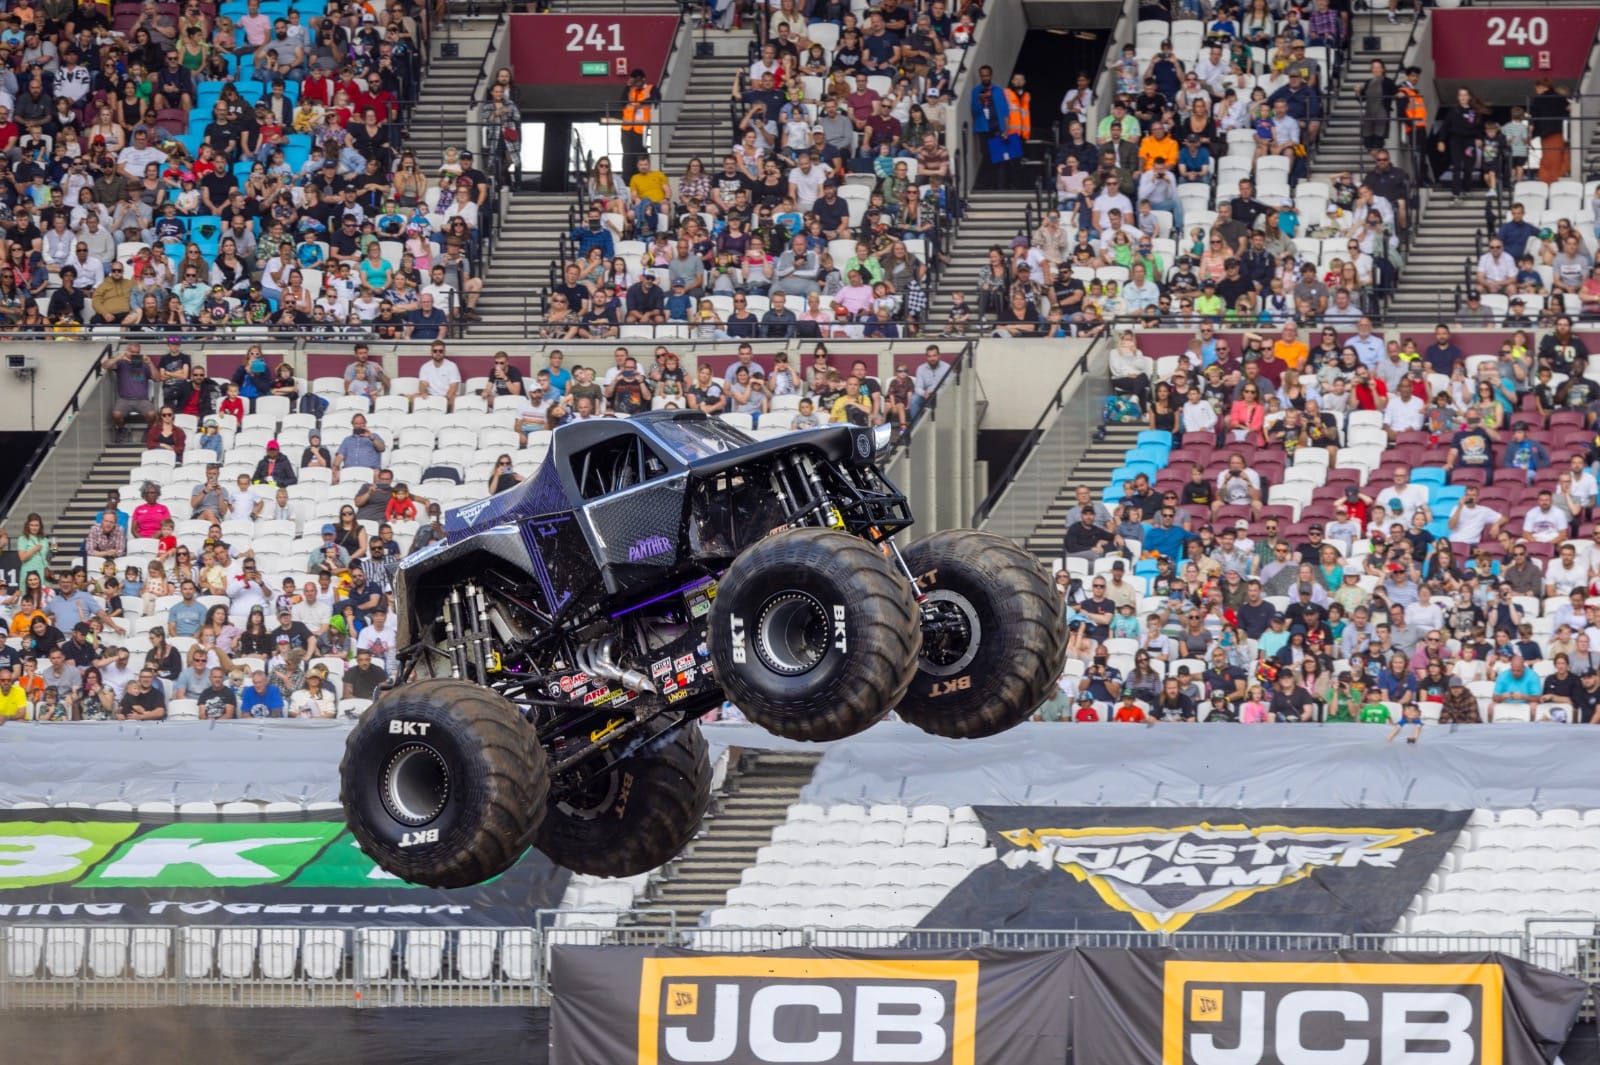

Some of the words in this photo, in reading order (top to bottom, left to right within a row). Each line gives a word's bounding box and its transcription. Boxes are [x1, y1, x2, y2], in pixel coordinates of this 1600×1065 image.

[565, 23, 625, 52] 241
[1487, 17, 1548, 46] 240
[628, 537, 672, 562] PANTHER
[915, 568, 938, 589] KT
[730, 613, 747, 664] BKT
[833, 604, 848, 654] BKT
[584, 686, 608, 702] ARP
[928, 675, 971, 698] BKT
[388, 719, 431, 736] BKT
[615, 771, 634, 819] BKT
[398, 828, 440, 848] BKT
[1000, 842, 1404, 870] MONSTER
[1116, 863, 1285, 887] JAM
[665, 984, 947, 1063] JCB
[1190, 990, 1474, 1065] JCB
